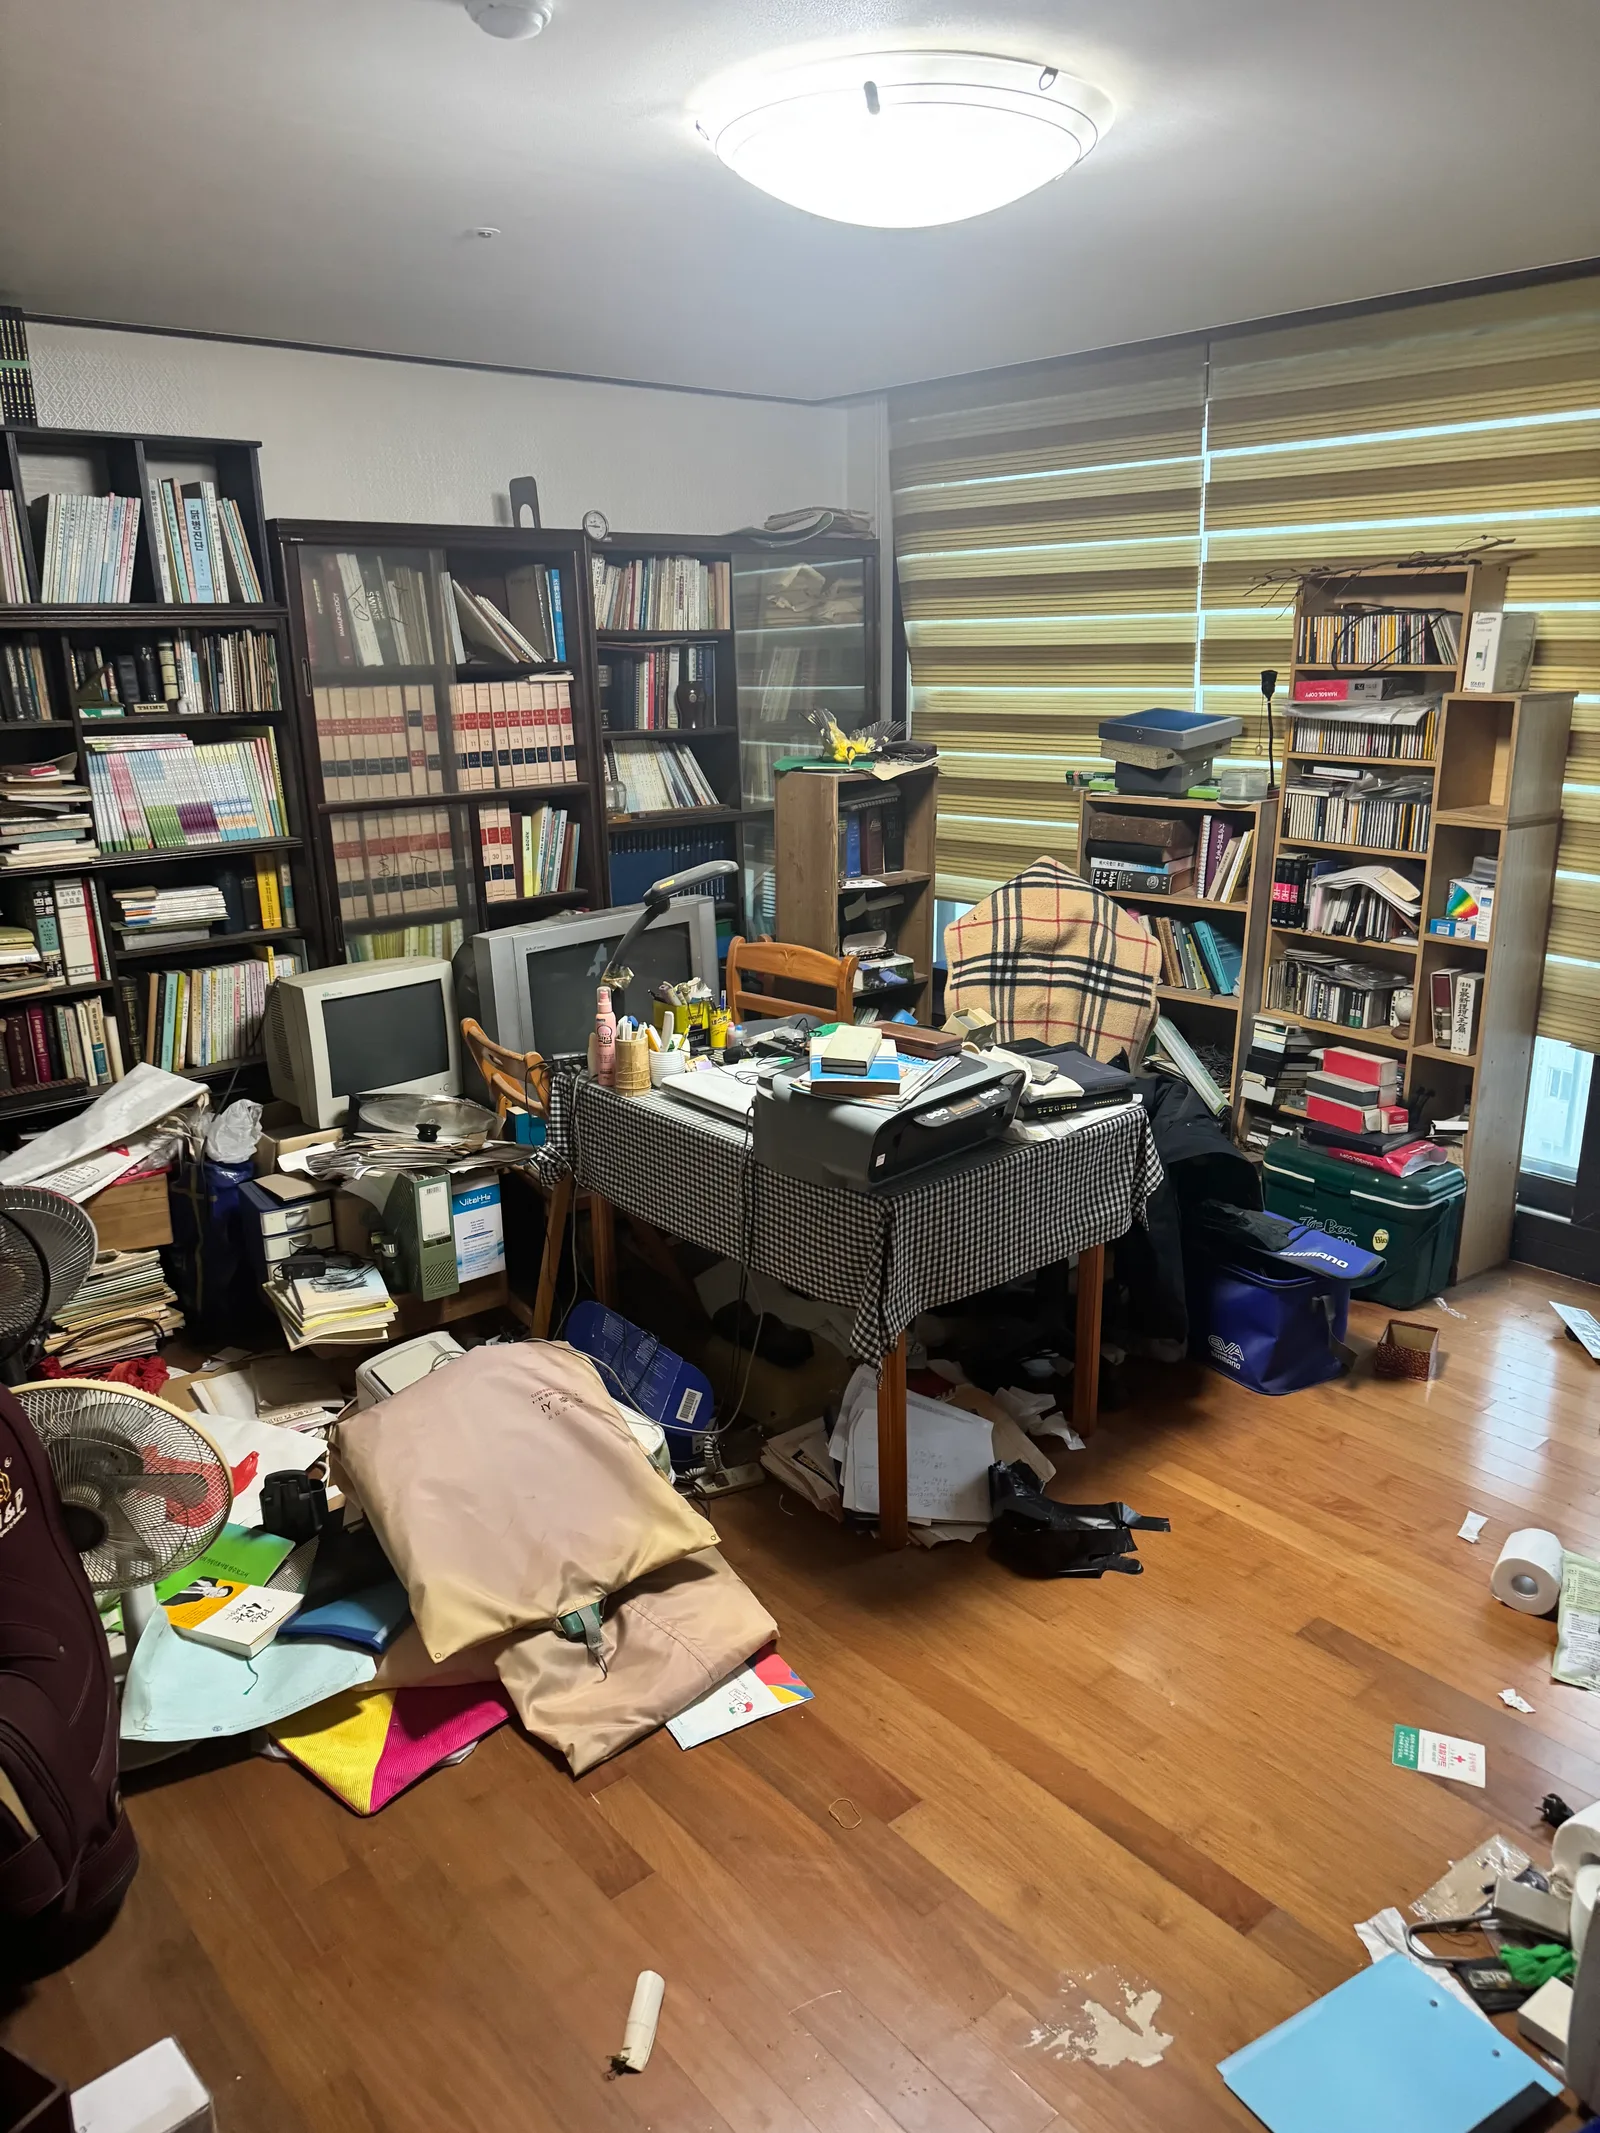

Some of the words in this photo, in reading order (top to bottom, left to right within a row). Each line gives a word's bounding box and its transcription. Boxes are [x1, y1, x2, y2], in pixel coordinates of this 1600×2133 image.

[136, 704, 167, 712] THINK
[1323, 1218, 1358, 1237] Box
[1279, 1251, 1349, 1269] SHIMANO
